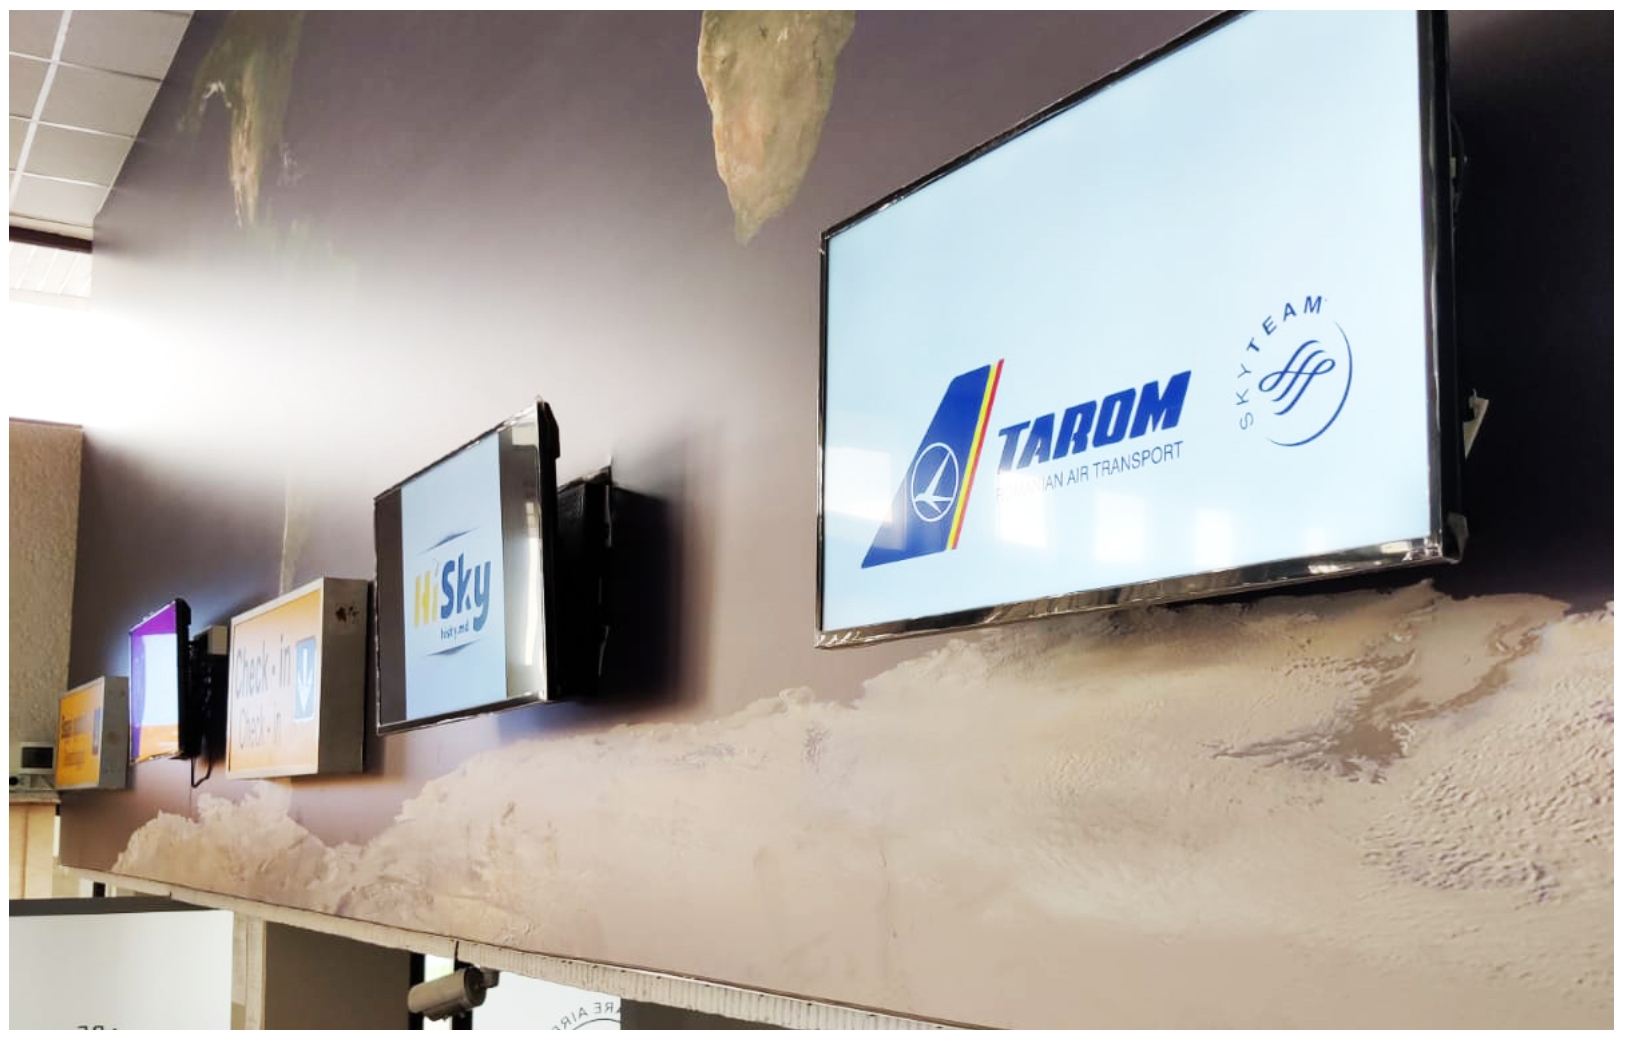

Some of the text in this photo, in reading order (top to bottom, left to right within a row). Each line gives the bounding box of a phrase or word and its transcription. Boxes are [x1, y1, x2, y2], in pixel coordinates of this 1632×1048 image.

[996, 369, 1193, 475] TAROM
[1066, 464, 1090, 487] AIR
[1092, 440, 1185, 480] TRANSPORT
[413, 552, 492, 633] HiSky
[234, 637, 270, 699] Check
[279, 633, 291, 689] in
